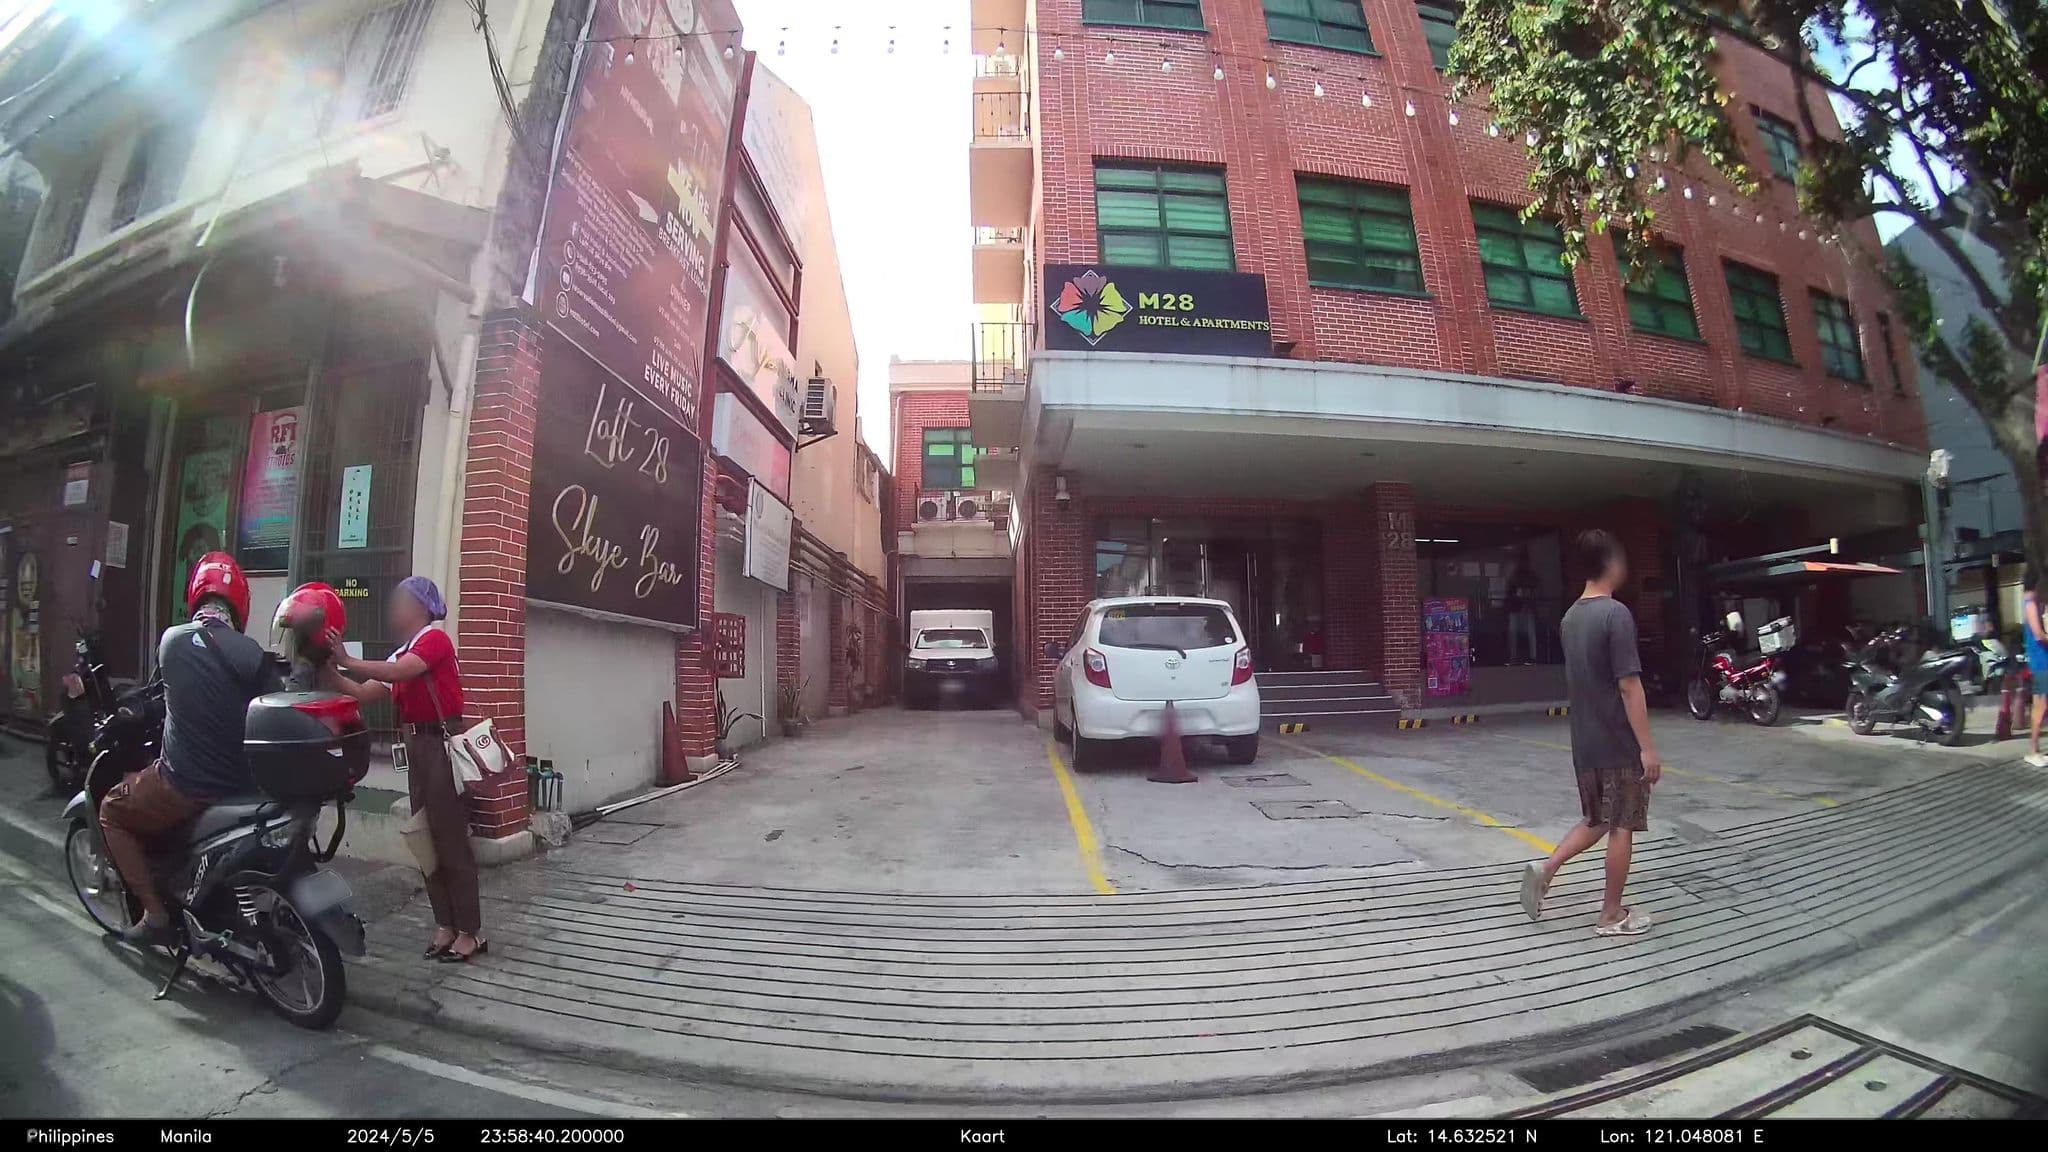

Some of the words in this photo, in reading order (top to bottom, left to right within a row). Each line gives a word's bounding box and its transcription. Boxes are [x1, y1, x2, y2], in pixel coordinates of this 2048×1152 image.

[666, 211, 705, 279] SERVING
[1138, 292, 1194, 311] M28
[1138, 315, 1180, 327] HOTEL
[1180, 318, 1192, 327] &
[1193, 317, 1270, 330] APARTMENTS
[644, 363, 671, 397] EVERY
[670, 386, 696, 420] FRIDAY
[652, 349, 670, 377] LIVE
[670, 365, 692, 398] MUSIC
[584, 382, 641, 470] Loft
[638, 427, 671, 485] 28
[551, 483, 629, 593] Skye
[634, 524, 683, 599] Bar
[334, 588, 369, 597] PARKING
[345, 578, 358, 588] NO
